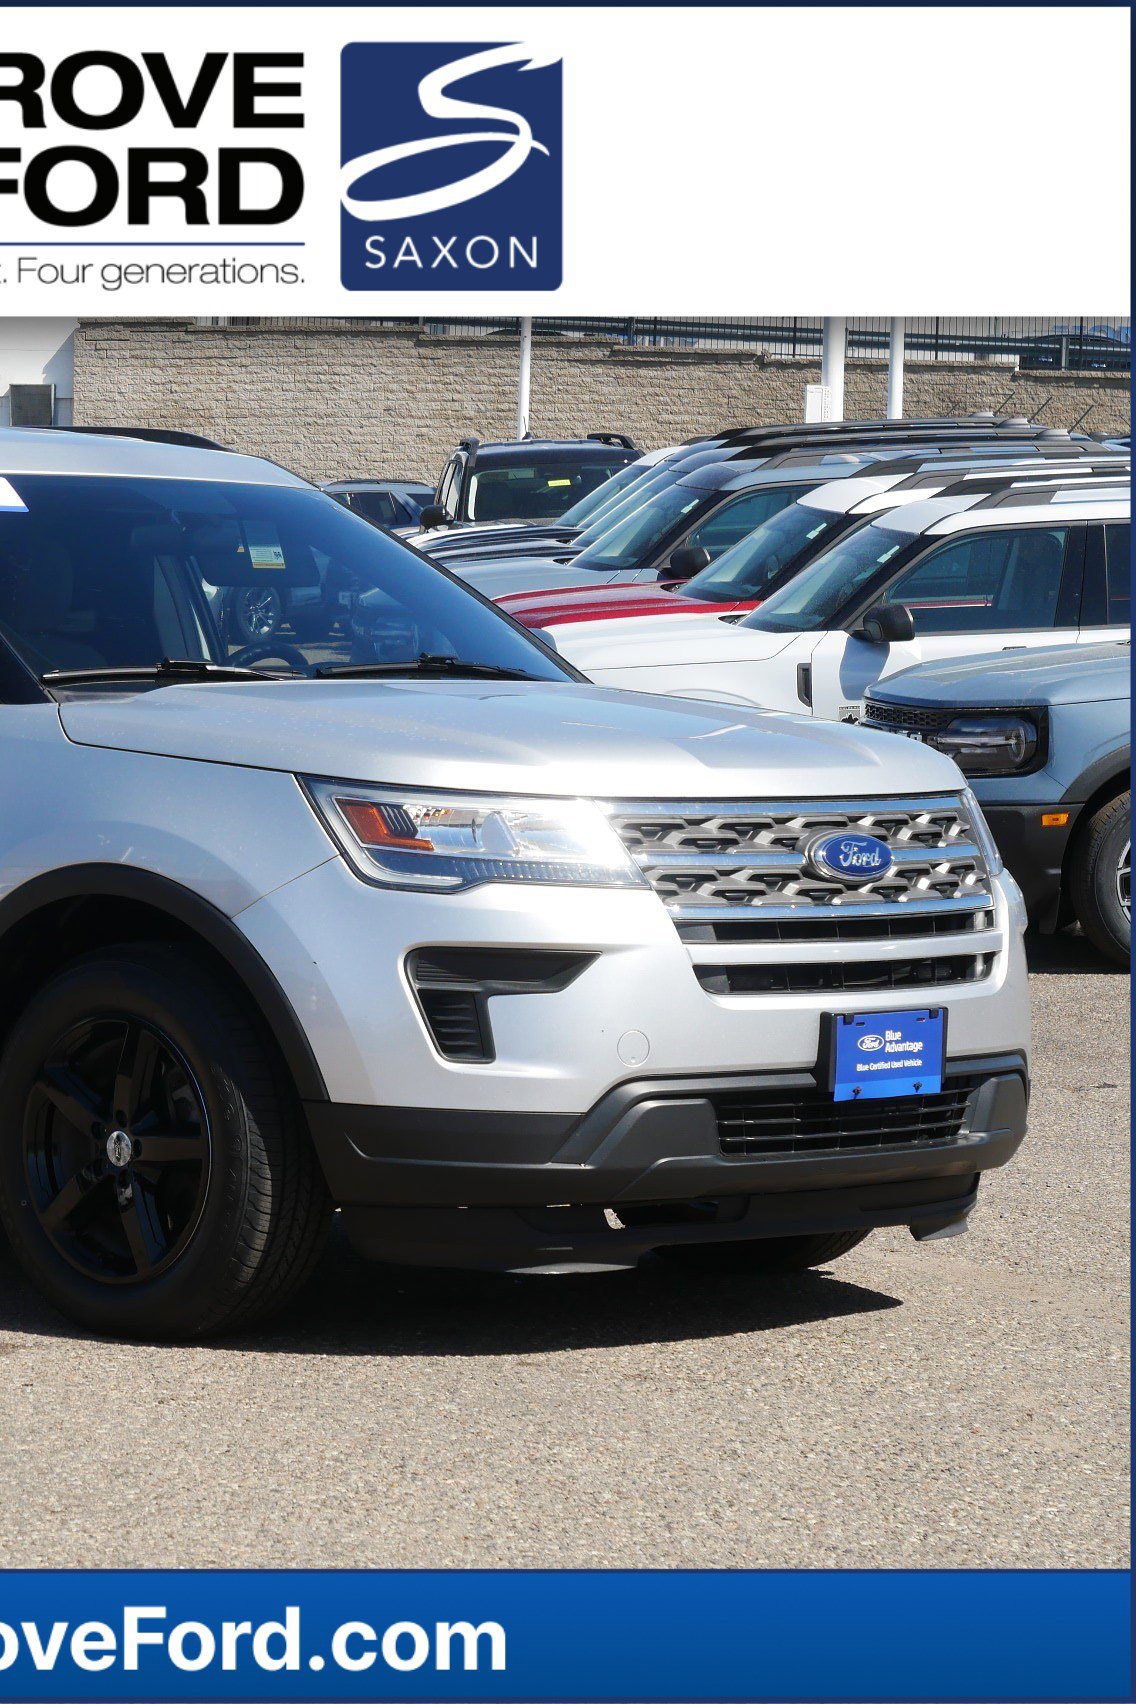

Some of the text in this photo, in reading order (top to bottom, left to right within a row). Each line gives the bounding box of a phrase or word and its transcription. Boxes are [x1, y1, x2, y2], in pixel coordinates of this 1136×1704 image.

[839, 840, 882, 868] Ford
[885, 1030, 902, 1041] Blue
[885, 1040, 924, 1053] Advantage
[856, 1063, 869, 1072] Blue
